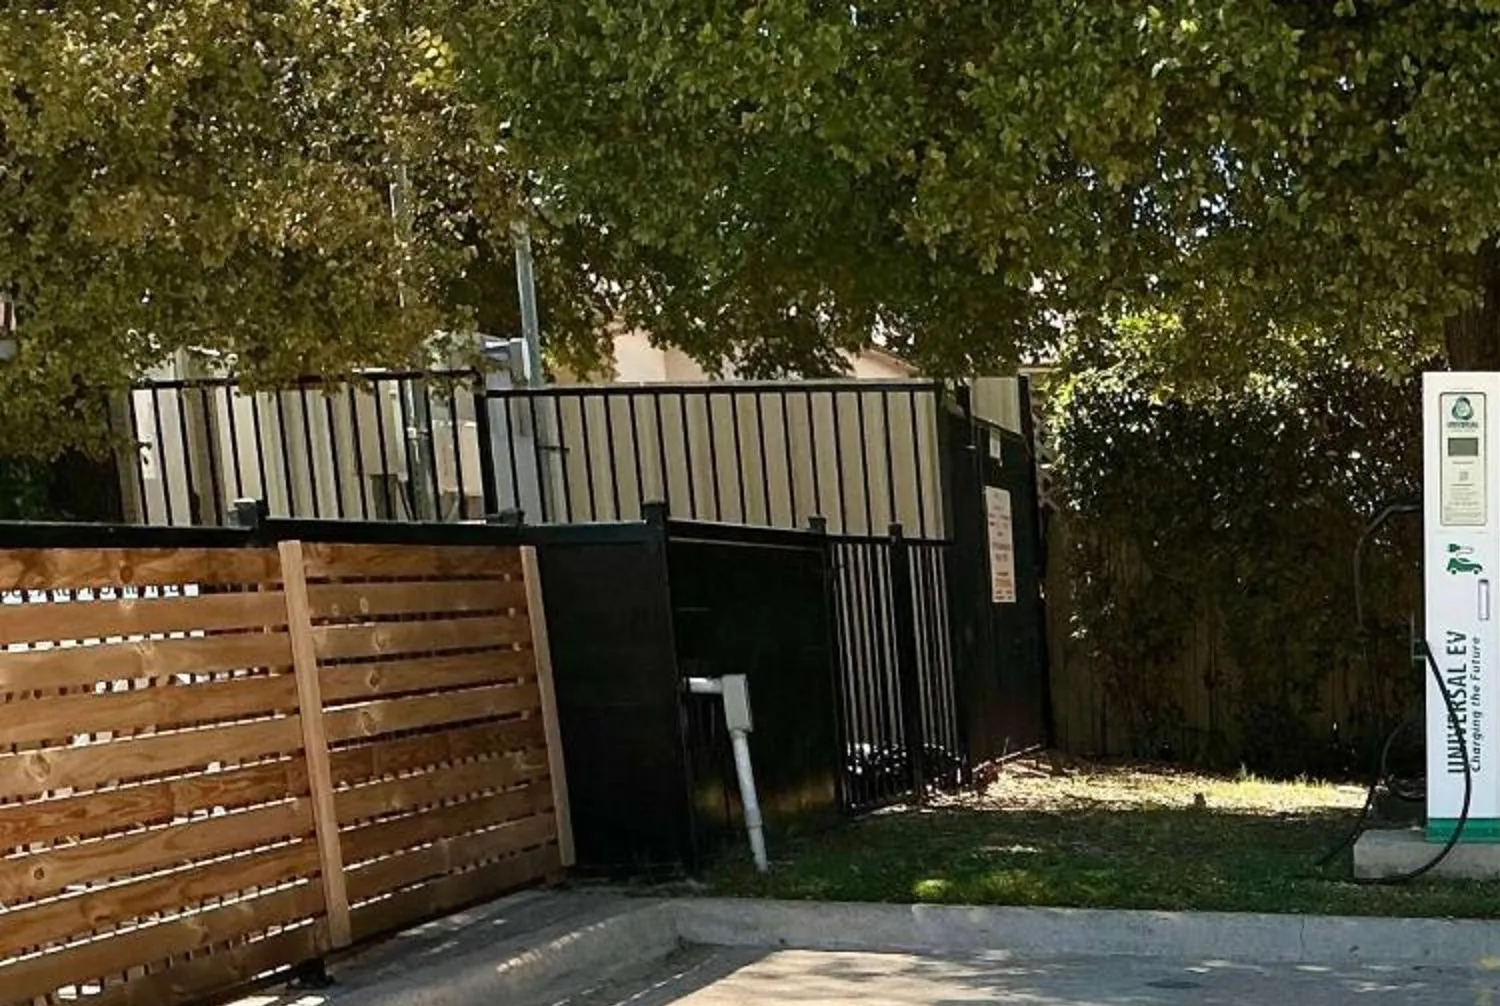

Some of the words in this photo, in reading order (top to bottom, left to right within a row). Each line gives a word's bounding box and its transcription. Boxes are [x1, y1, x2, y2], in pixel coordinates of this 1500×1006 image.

[1446, 631, 1467, 655] EV
[1470, 637, 1481, 681] Future
[1446, 663, 1468, 773] UNIVERSAL
[1471, 685, 1481, 707] the
[1470, 710, 1482, 773] Charging
